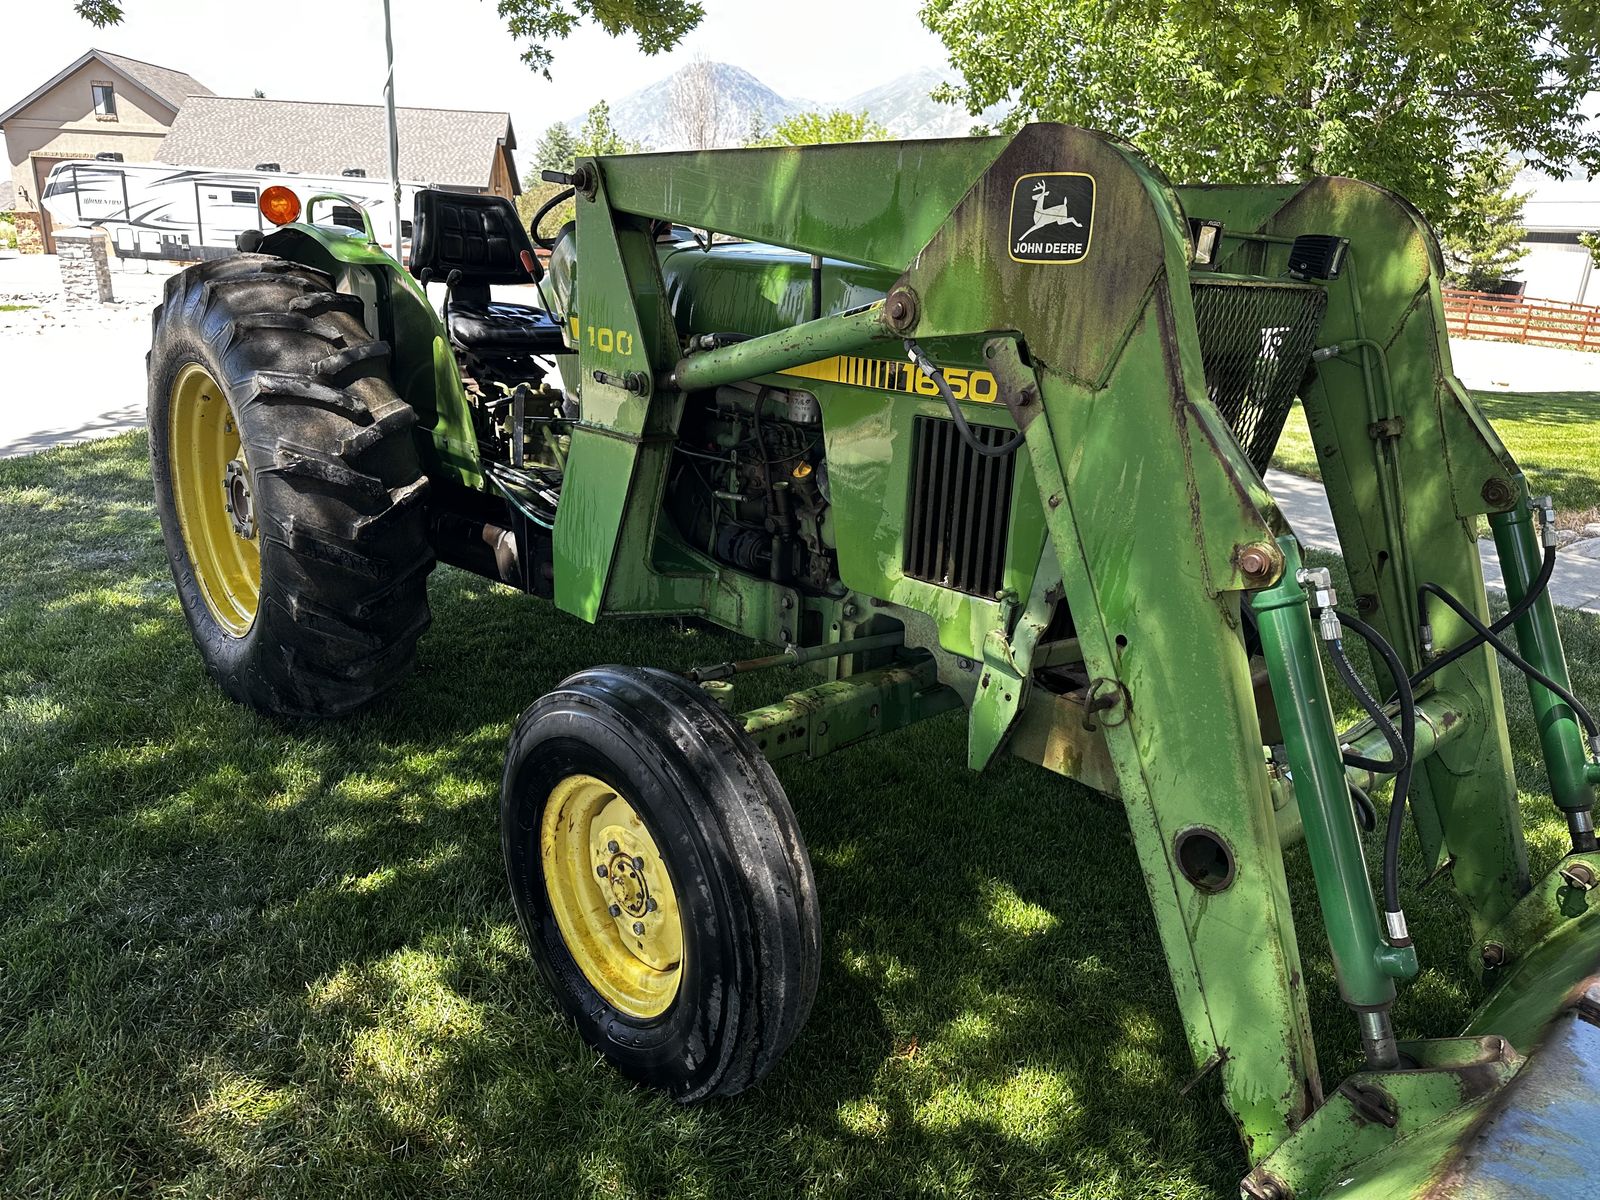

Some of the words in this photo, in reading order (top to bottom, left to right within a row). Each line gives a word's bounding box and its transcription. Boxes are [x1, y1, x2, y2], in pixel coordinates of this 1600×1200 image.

[1013, 242, 1043, 254] JOHN
[1045, 242, 1083, 254] DEERE
[587, 326, 633, 356] 100
[902, 362, 998, 403] 1650
